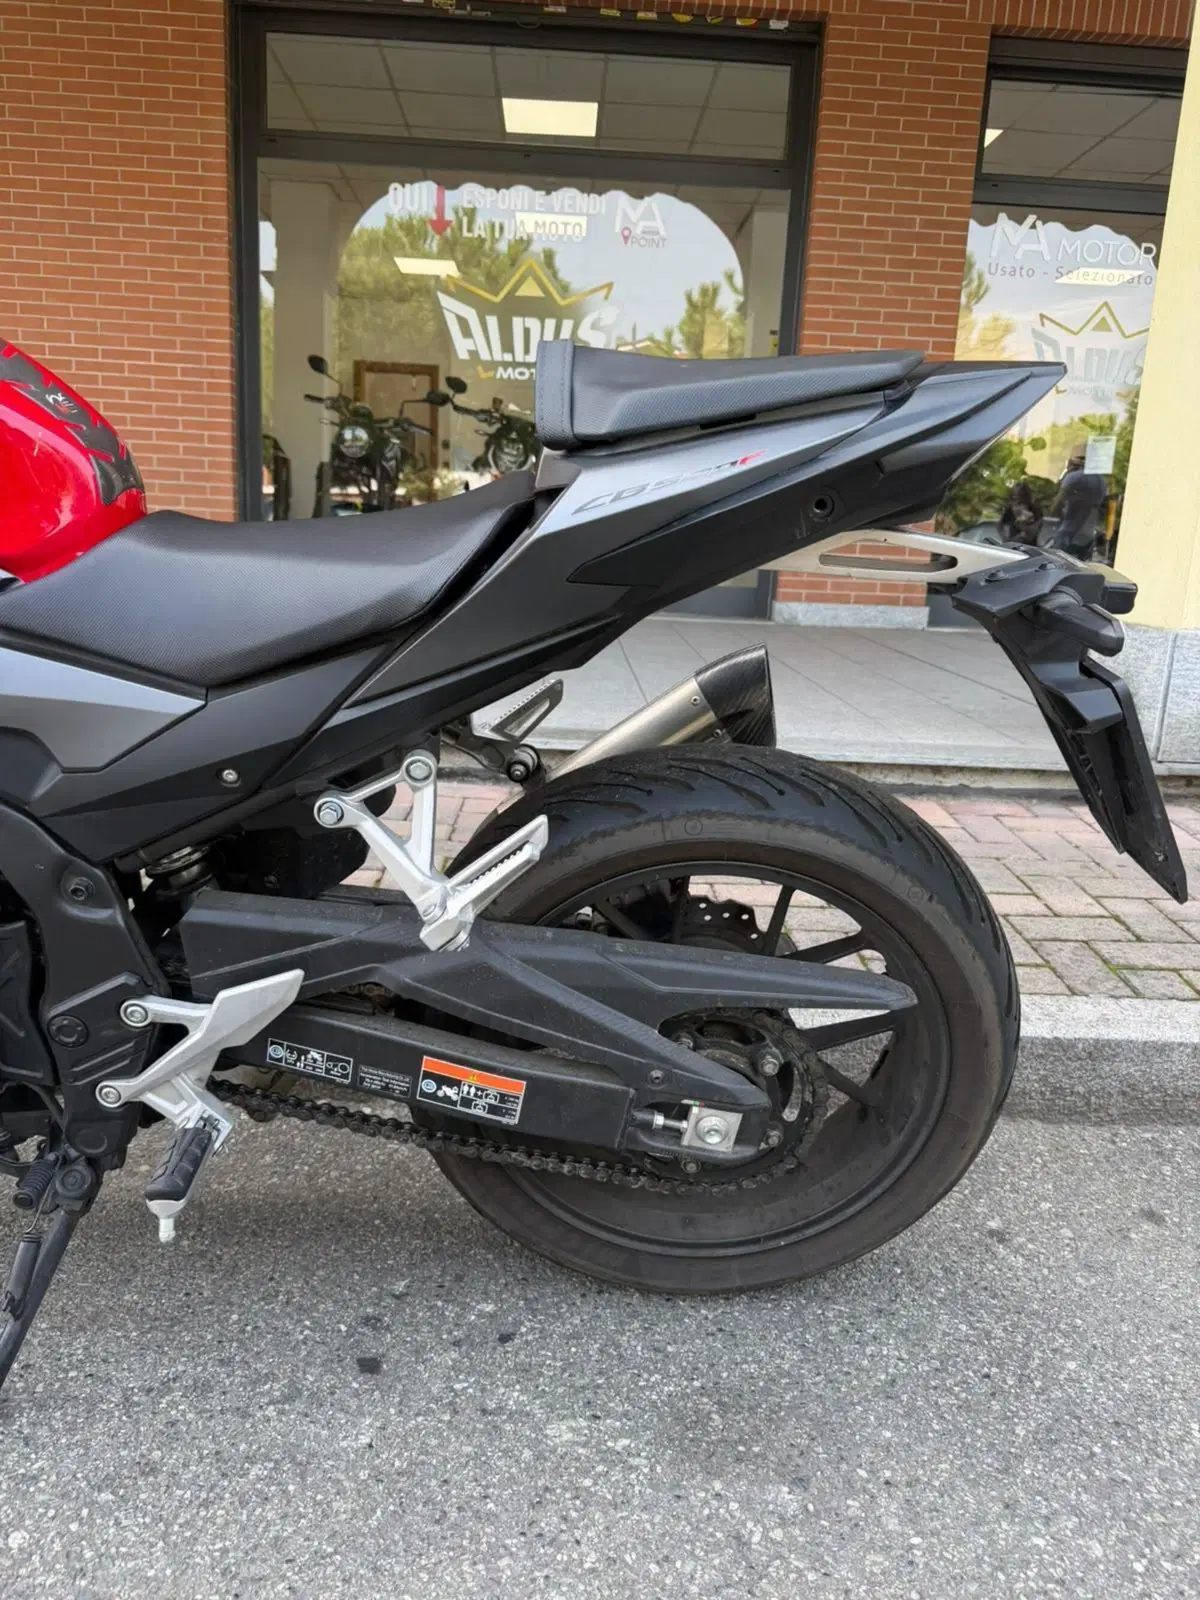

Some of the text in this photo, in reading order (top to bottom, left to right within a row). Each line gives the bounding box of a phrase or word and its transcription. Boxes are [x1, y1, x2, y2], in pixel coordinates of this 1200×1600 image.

[388, 182, 429, 214] QUI
[462, 186, 606, 215] ESPONI E VENDI
[462, 216, 585, 243] LA TUA MOTO
[630, 236, 667, 249] POINT
[988, 262, 1036, 278] Usato
[1055, 266, 1153, 286] Selezionato
